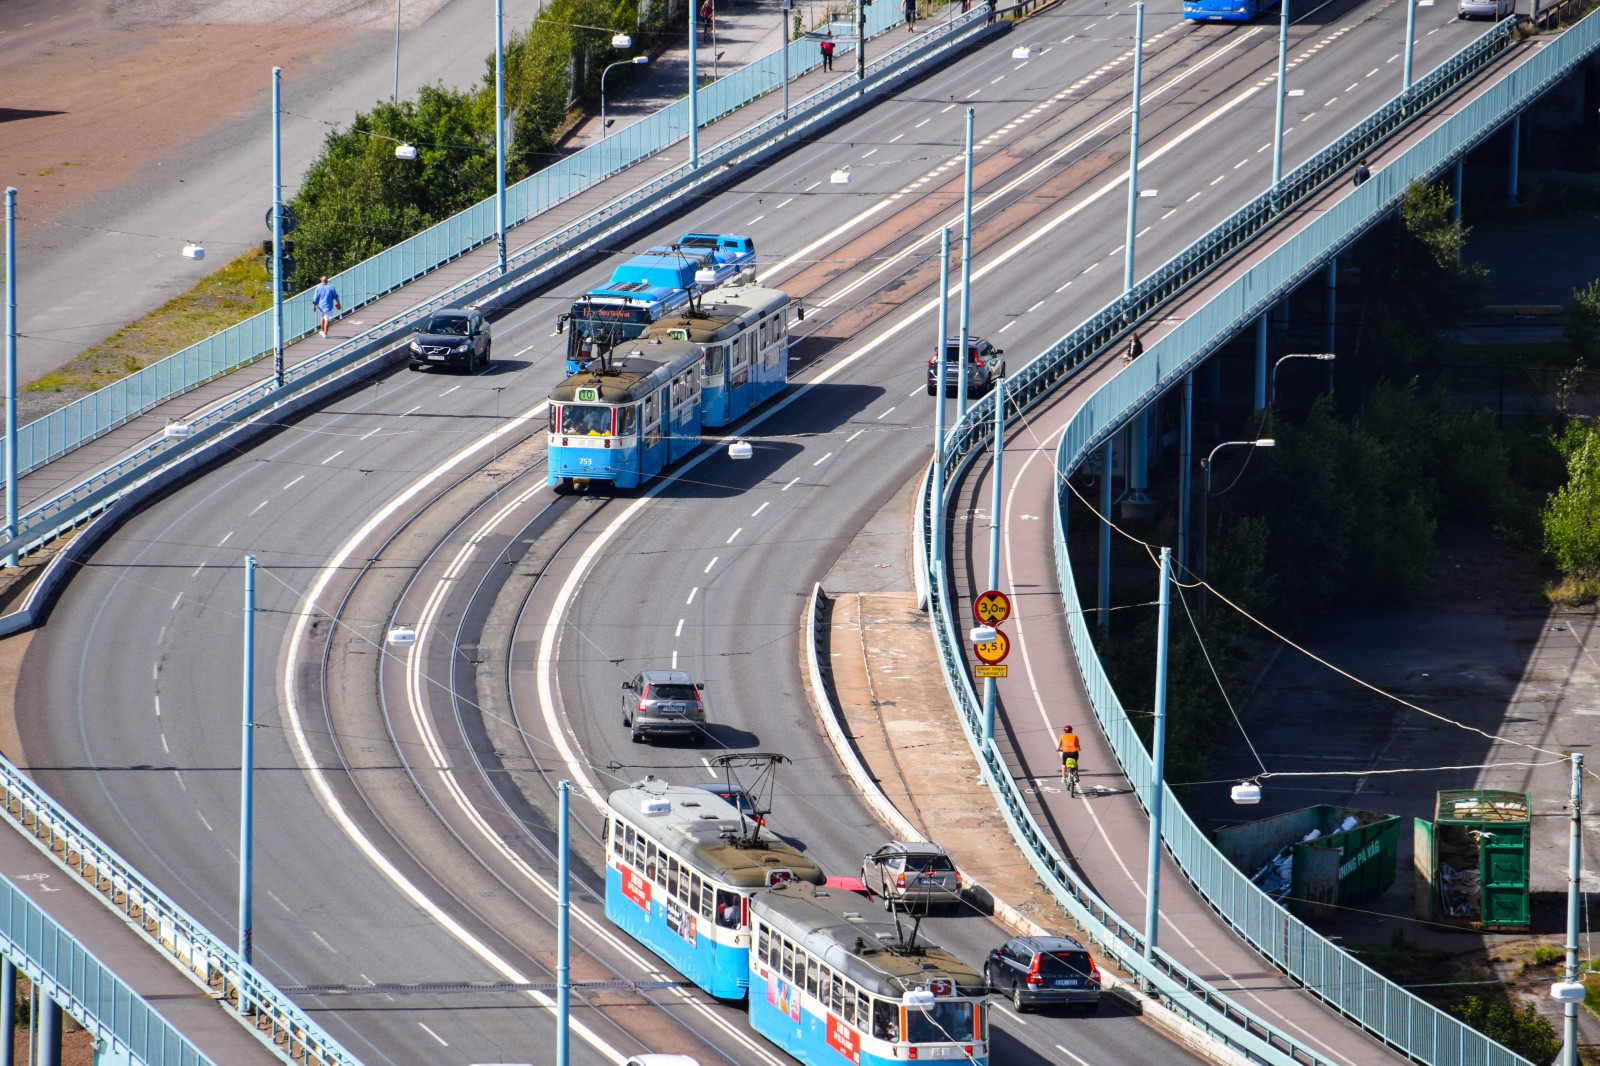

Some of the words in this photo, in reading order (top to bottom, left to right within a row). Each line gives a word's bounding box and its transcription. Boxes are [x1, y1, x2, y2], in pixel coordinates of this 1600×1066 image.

[582, 390, 593, 400] 10
[579, 458, 592, 466] 753
[937, 980, 945, 993] 5
